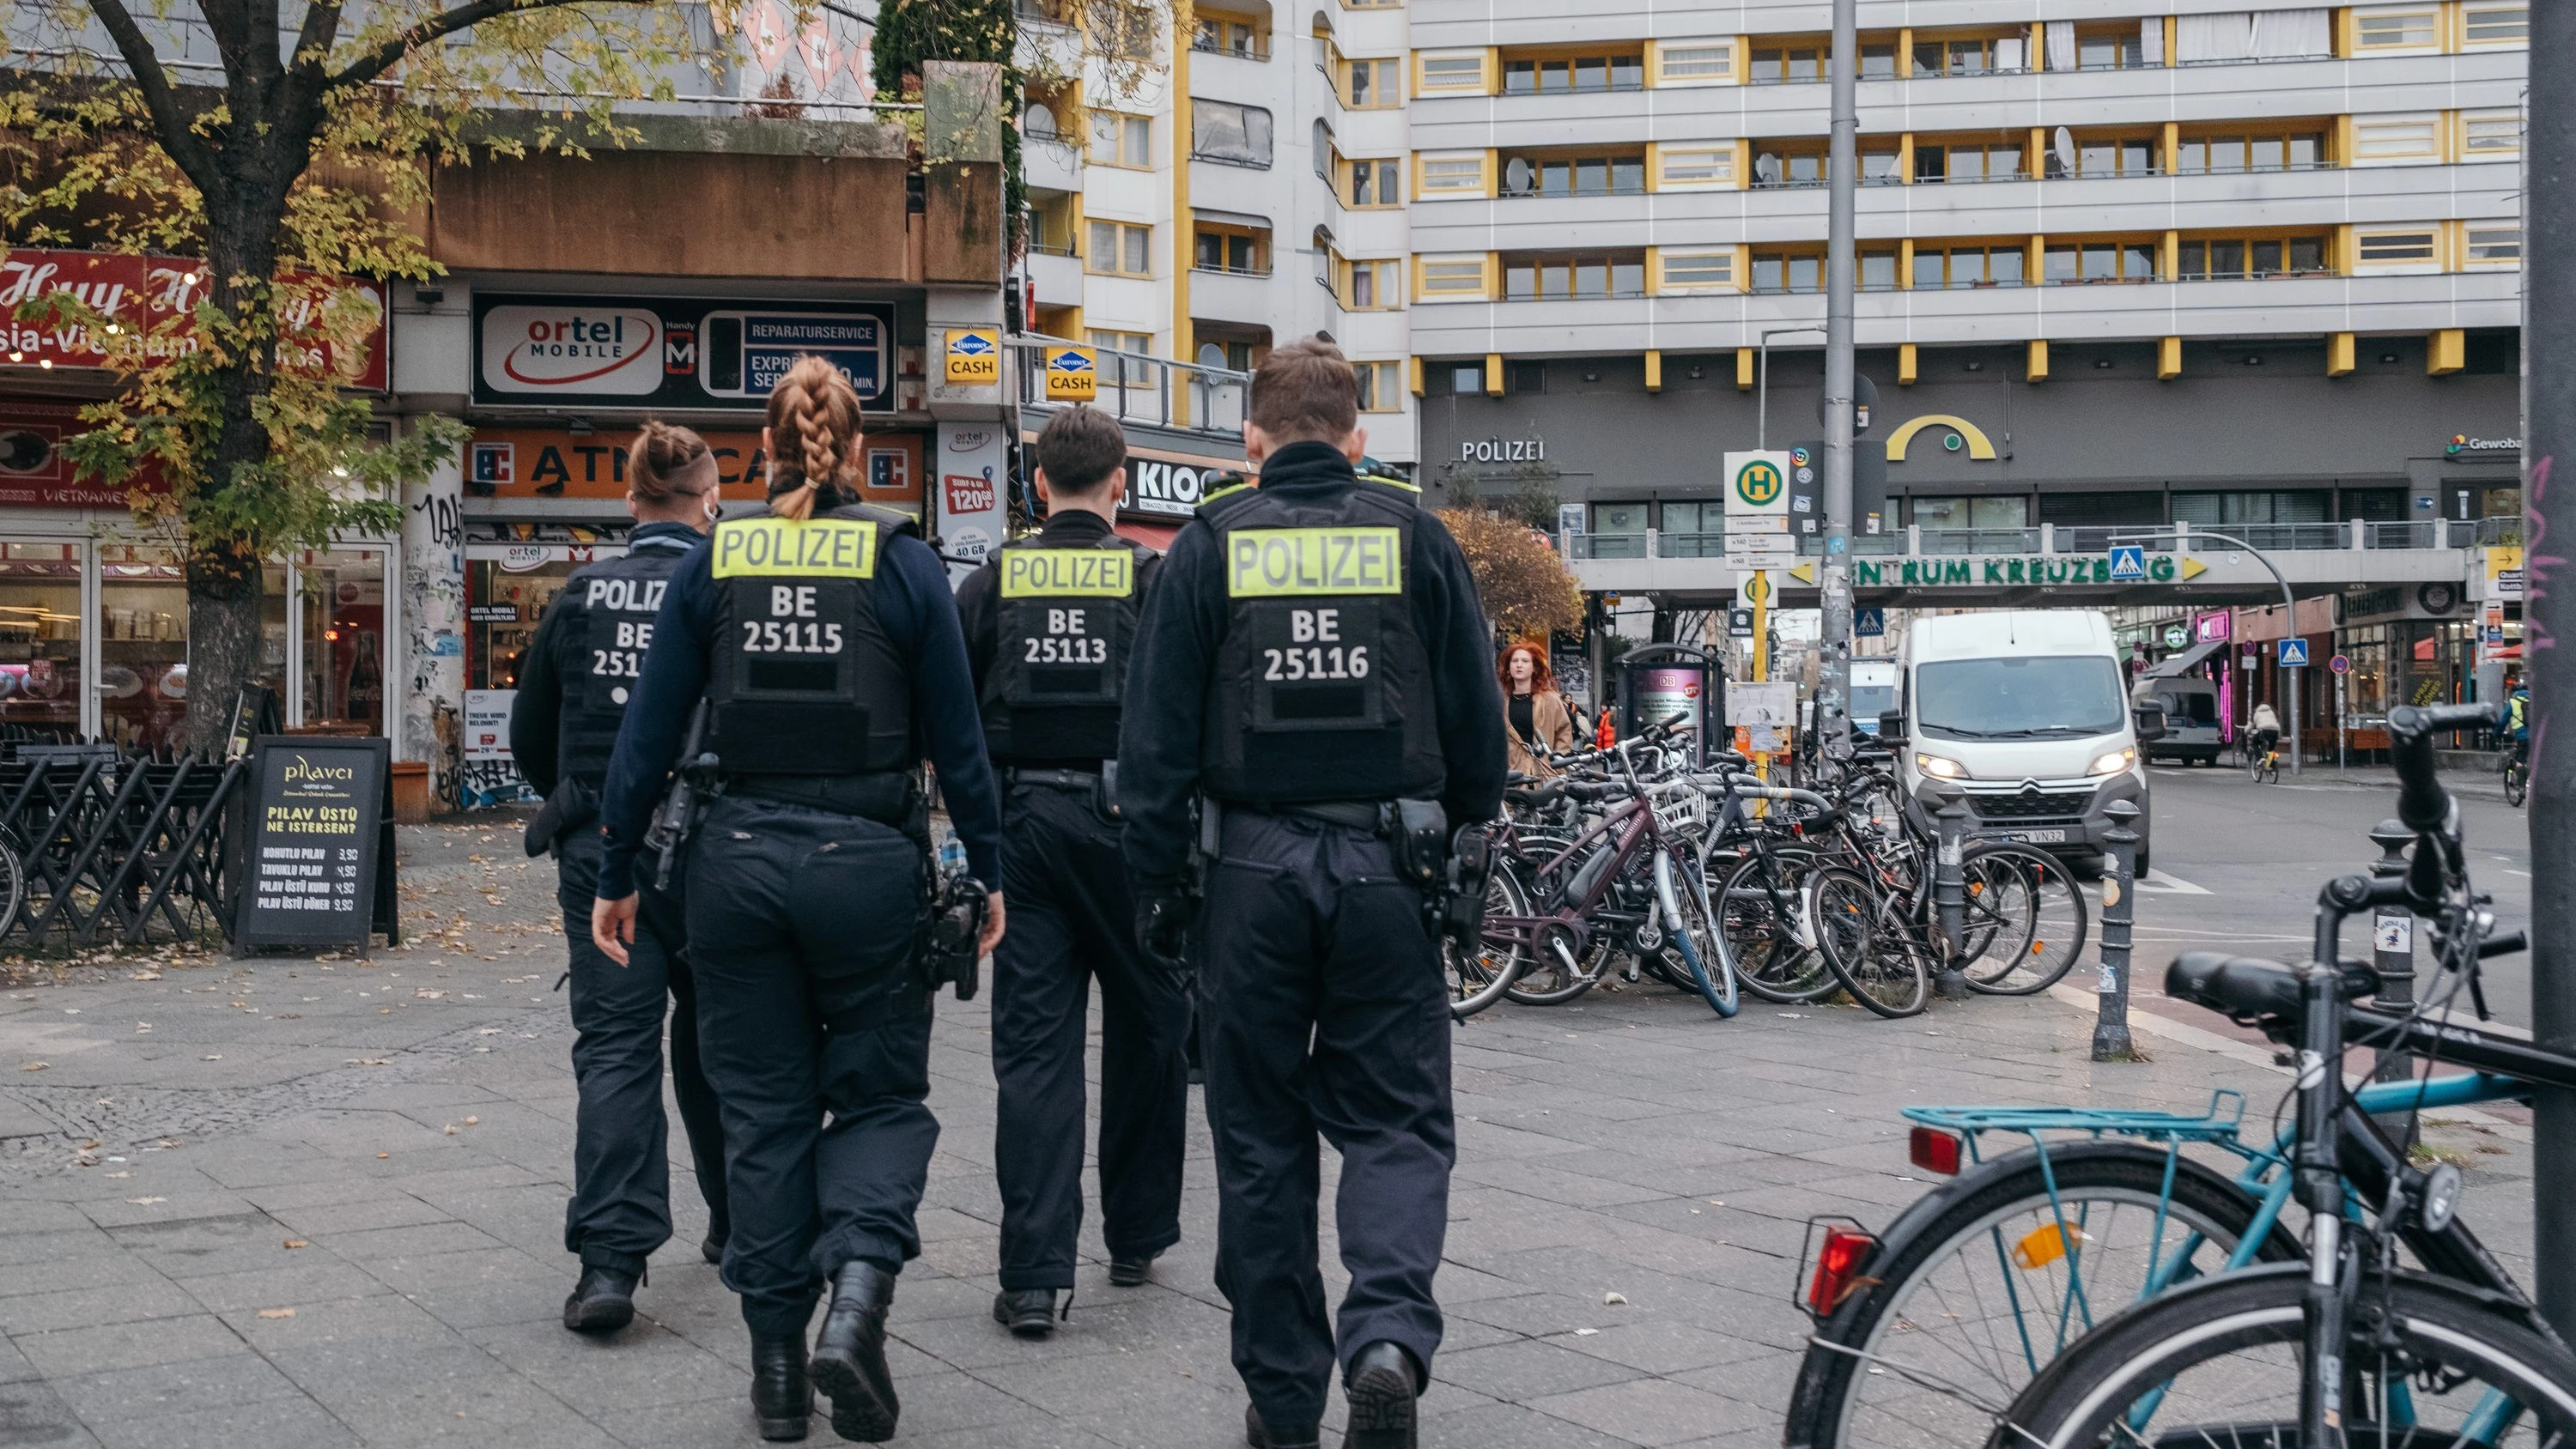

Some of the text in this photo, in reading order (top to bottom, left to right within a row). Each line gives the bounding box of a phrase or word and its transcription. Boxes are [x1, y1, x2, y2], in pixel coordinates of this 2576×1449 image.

[528, 316, 623, 343] ortel
[666, 321, 695, 330] Handy
[752, 324, 872, 340] REPARATURSERVICE
[531, 344, 622, 357] MOBILE
[957, 338, 988, 351] Euronet
[951, 361, 993, 373] CASH
[1056, 355, 1088, 368] Euronet
[854, 378, 875, 389] MIN.
[1051, 377, 1091, 390] CASH
[1462, 441, 1545, 462] POLIZEI
[2469, 438, 2523, 450] Gewoba
[1137, 461, 1210, 504] KIO
[1748, 471, 1771, 495] H
[951, 489, 982, 511] 120
[509, 546, 541, 556] ortel
[721, 529, 865, 568] POLIZEI
[971, 545, 985, 555] GB
[1235, 536, 1394, 589] POLIZEI
[1851, 555, 2175, 585] NTRUM KREUZBG
[1010, 556, 1124, 589] POLIZEI
[2499, 570, 2523, 579] Quart
[2499, 582, 2523, 591] Kottb
[586, 579, 668, 611] POLIZ
[771, 585, 817, 617] BE
[1048, 609, 1085, 634] BE
[1291, 609, 1340, 642] BE
[617, 622, 654, 649] BE
[743, 621, 843, 654] 25115
[1024, 638, 1107, 664] 25113
[592, 650, 641, 677] 251
[1264, 646, 1369, 681] 25116
[1661, 676, 1674, 686] DB
[268, 806, 358, 822] PILAV ÜSTÜ
[267, 822, 356, 834] NE ISTERSEN?
[263, 847, 301, 858] NOHUTLU
[301, 847, 325, 859] PILAV
[262, 864, 298, 876] TAVUKLU
[299, 864, 323, 876] PILAV
[259, 881, 284, 892] PILAV
[285, 879, 307, 892] ÜSTÜ
[258, 897, 282, 908] PILAV
[282, 895, 303, 909] ÜSTÜ
